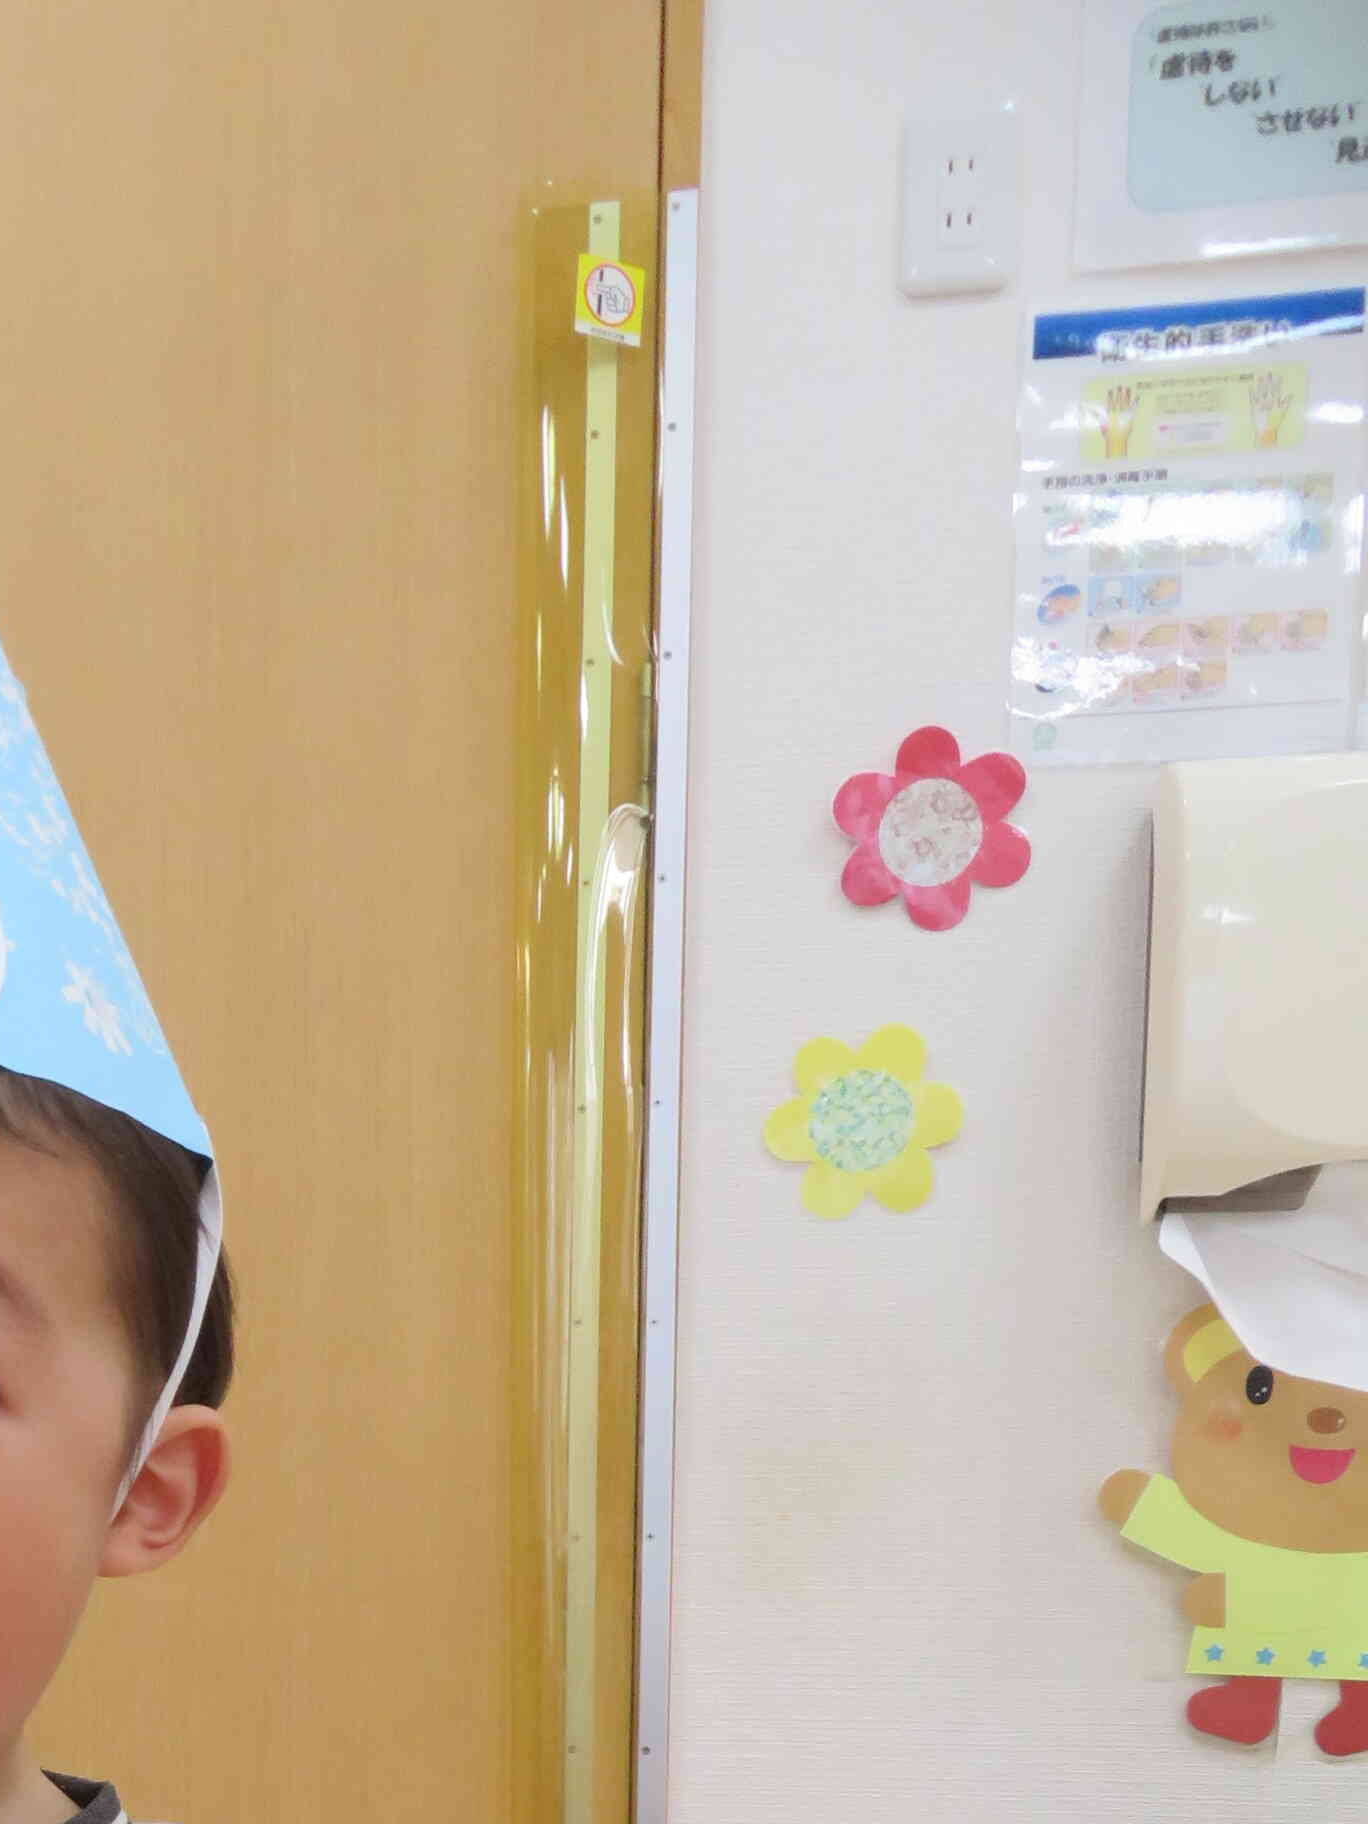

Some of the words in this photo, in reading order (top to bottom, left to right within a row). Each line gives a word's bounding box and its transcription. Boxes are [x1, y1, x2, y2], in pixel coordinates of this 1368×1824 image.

[1158, 48, 1237, 81] 虐待を
[1204, 77, 1276, 107] しない
[1256, 102, 1356, 135] させない
[1335, 134, 1368, 164] 見
